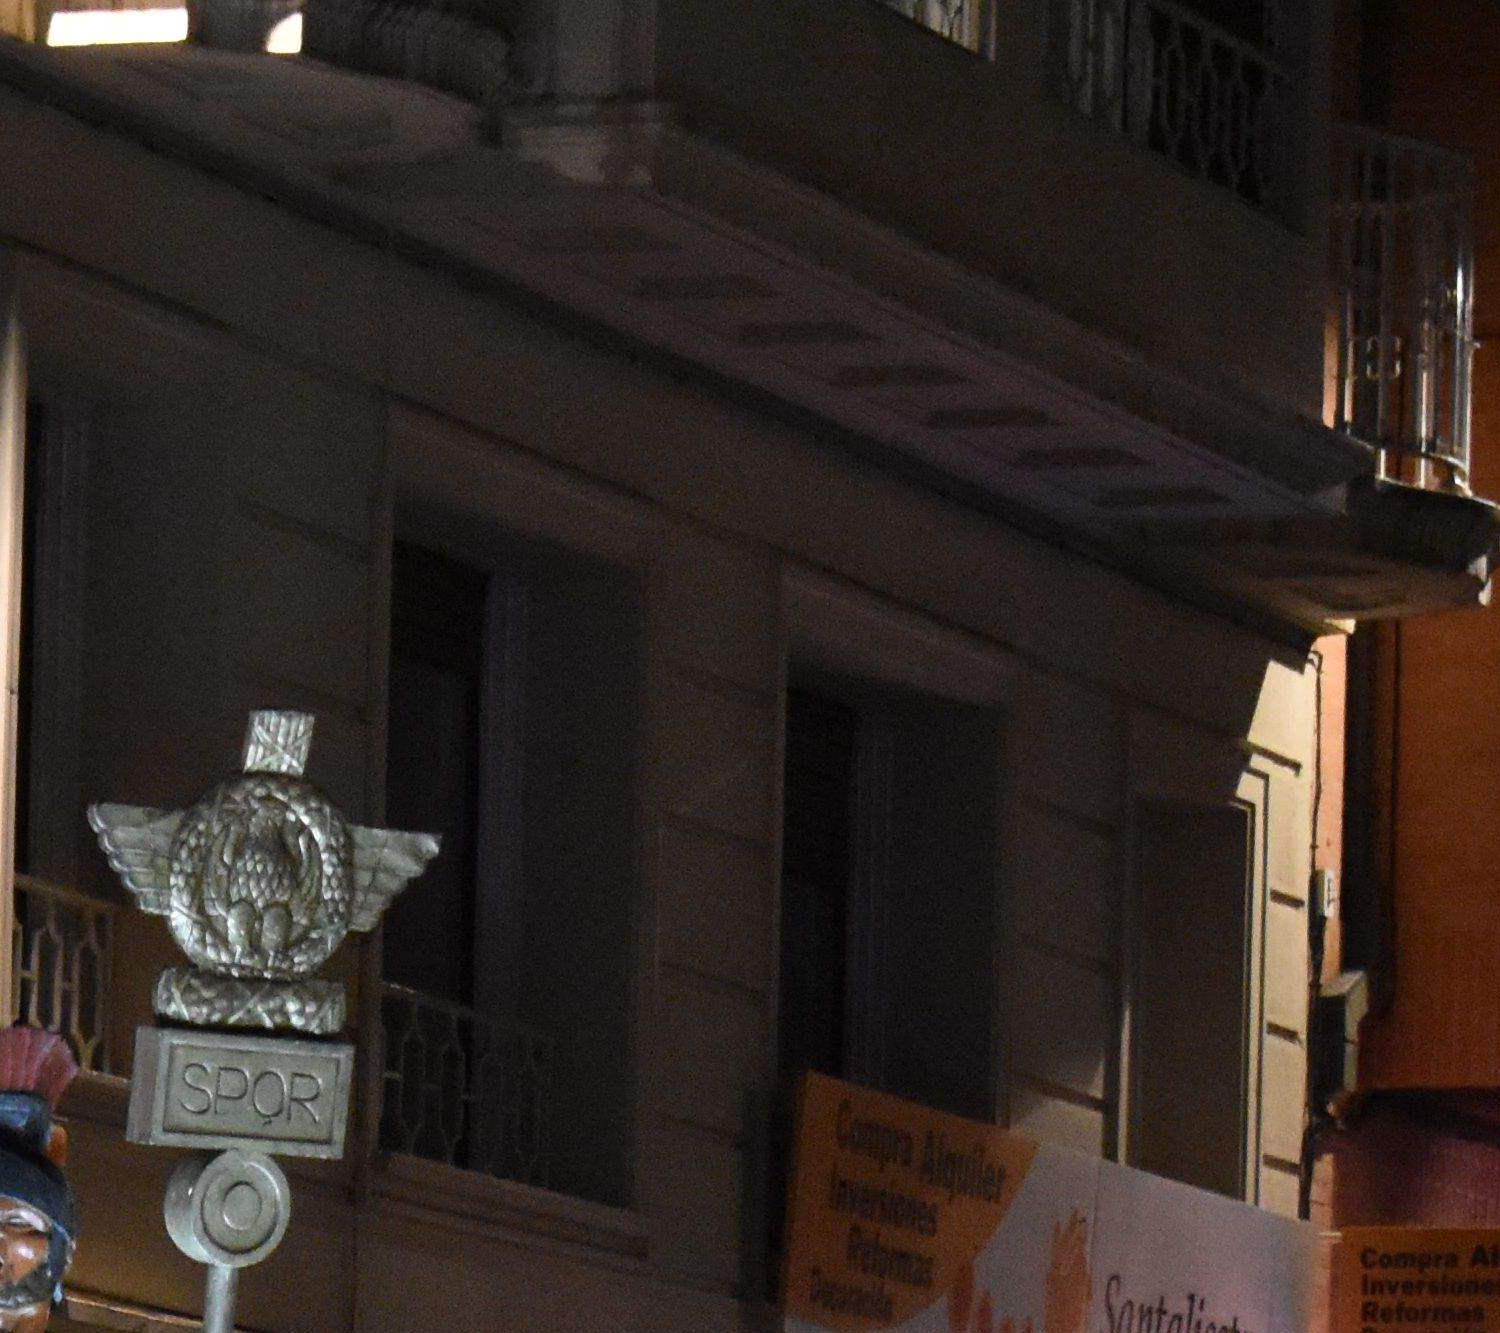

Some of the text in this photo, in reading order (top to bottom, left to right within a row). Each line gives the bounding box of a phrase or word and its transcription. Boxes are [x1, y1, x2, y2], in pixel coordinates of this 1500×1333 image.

[179, 1062, 323, 1126] SPQR
[837, 1098, 1008, 1204] Compra Alquiler
[1361, 1248, 1459, 1273] Compra
[1361, 1302, 1486, 1324] Reformas
